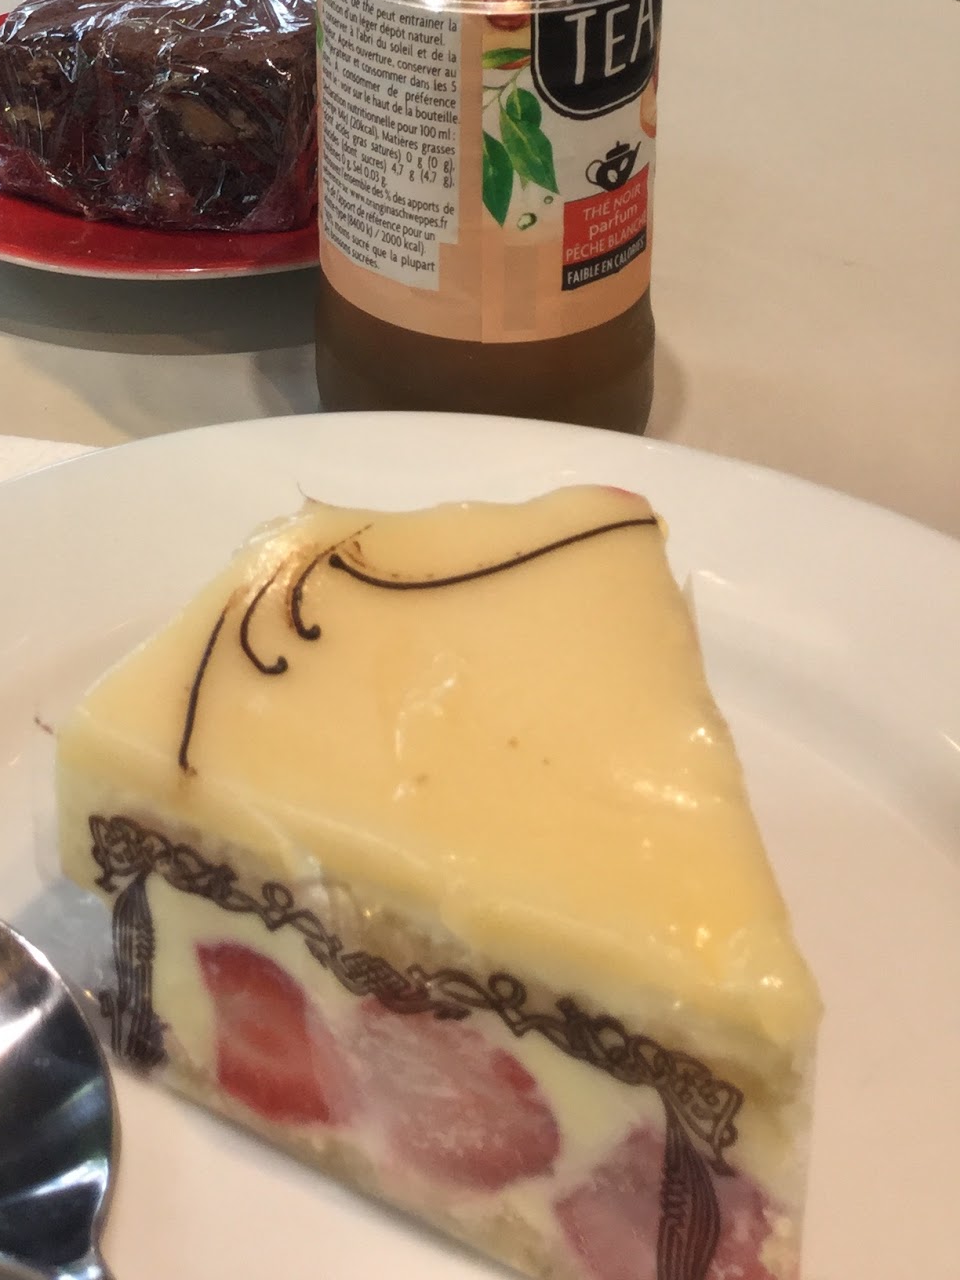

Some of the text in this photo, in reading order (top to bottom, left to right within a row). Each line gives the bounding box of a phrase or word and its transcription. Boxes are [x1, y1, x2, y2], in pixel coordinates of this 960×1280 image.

[358, 13, 378, 32] léger
[379, 21, 405, 40] dépôt
[362, 0, 374, 15] thé
[376, 8, 395, 22] peut
[448, 16, 458, 32] la
[376, 35, 387, 50] du
[389, 38, 413, 56] soleil
[416, 48, 427, 59] et
[430, 47, 444, 61] de
[448, 49, 457, 63] la
[396, 60, 441, 76] conserver
[444, 68, 457, 78] au
[387, 83, 398, 98] de
[404, 91, 456, 109] préférence
[409, 75, 430, 90] dans
[433, 78, 447, 92] les
[364, 90, 371, 104] le
[372, 93, 390, 111] haut
[391, 100, 403, 115] de
[405, 101, 413, 117] la
[381, 130, 418, 150] Matières
[421, 142, 455, 159] grasses
[396, 122, 417, 134] pour
[420, 124, 436, 138] 100
[438, 127, 451, 140] ml
[352, 134, 367, 148] gras
[370, 142, 401, 164] saturés)
[405, 151, 413, 163] 0
[416, 156, 423, 169] g
[427, 155, 438, 171] (0
[360, 153, 387, 173] sucres)
[408, 169, 415, 182] g
[392, 191, 406, 206] des
[407, 198, 439, 213] apports
[442, 201, 455, 215] de
[583, 183, 641, 221] THÉ NOIR
[356, 204, 365, 218] de
[365, 211, 401, 232] référence
[401, 225, 422, 238] pour
[424, 231, 435, 241] un
[589, 204, 638, 241] parfum
[381, 230, 402, 247] 2000
[566, 240, 605, 262] PÊCHE
[351, 234, 370, 251] sucré
[371, 245, 387, 258] que
[389, 249, 398, 262] la
[400, 254, 435, 272] plupart
[567, 265, 600, 285] FAIBLE
[601, 259, 614, 274] EN
